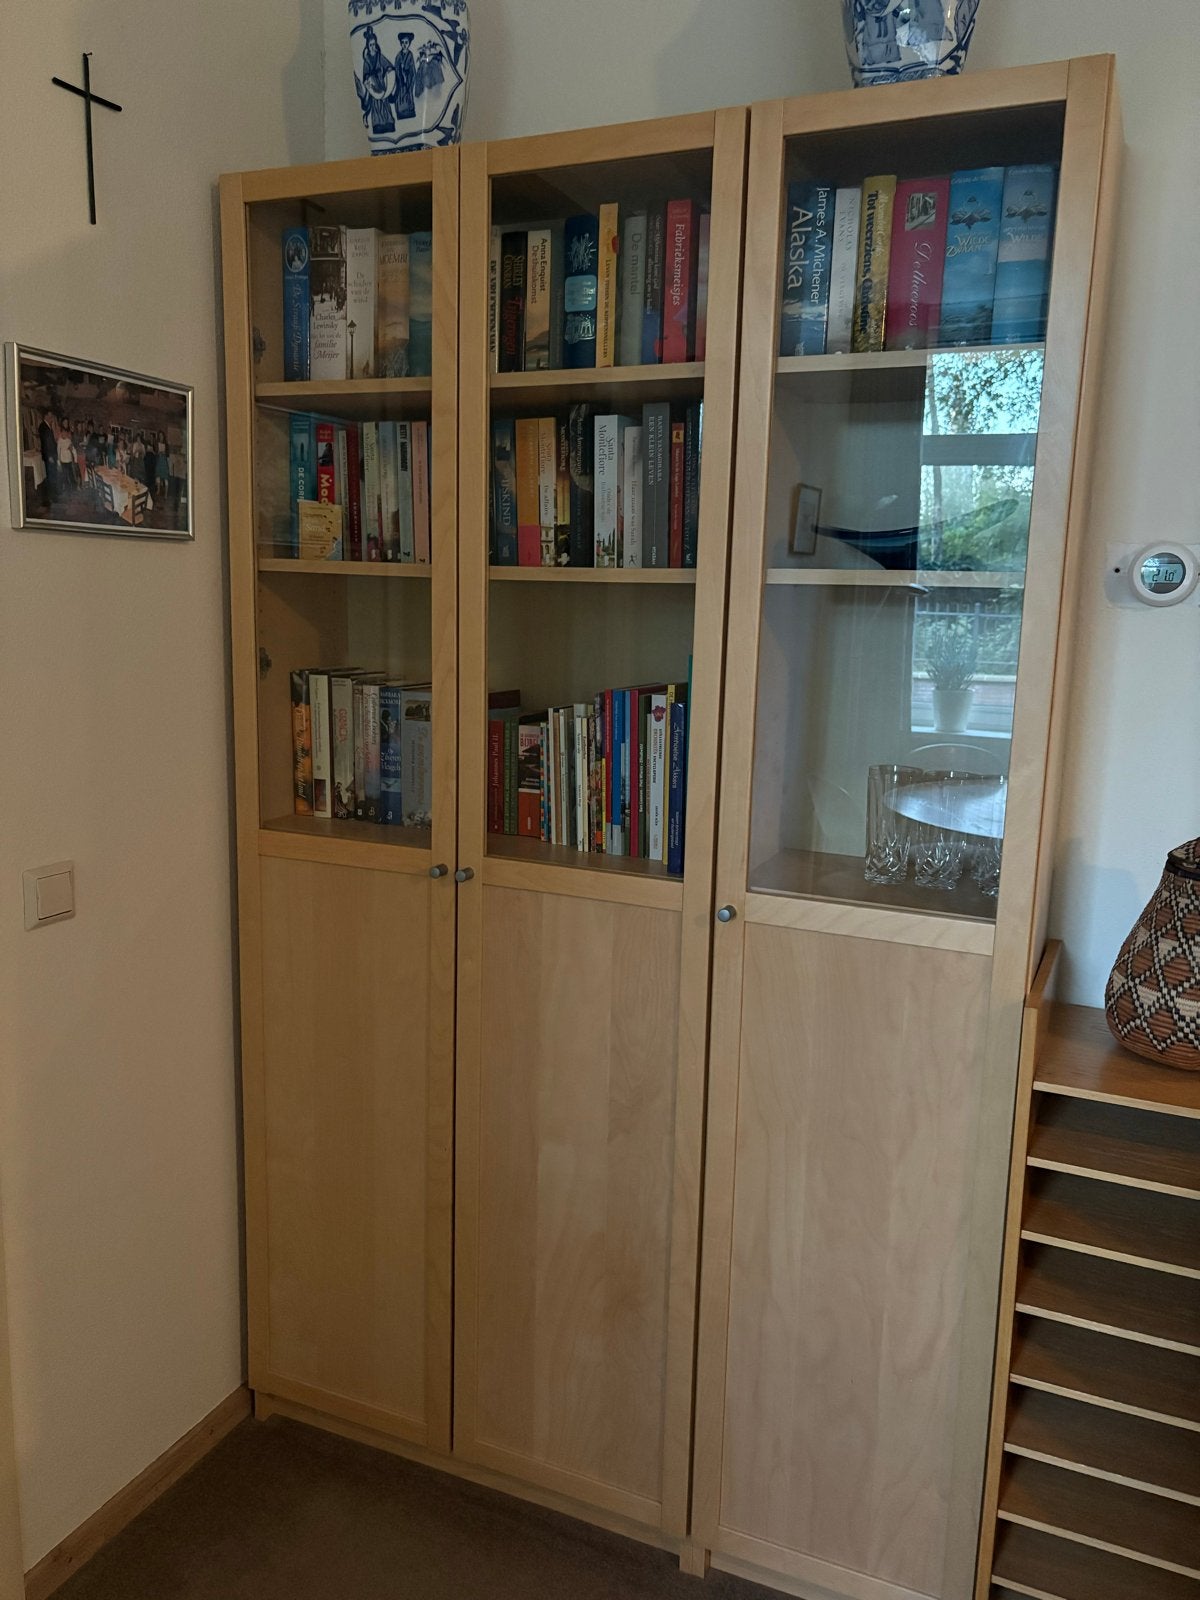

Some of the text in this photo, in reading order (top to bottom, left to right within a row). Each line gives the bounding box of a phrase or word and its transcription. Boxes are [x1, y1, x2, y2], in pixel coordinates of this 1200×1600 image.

[538, 238, 548, 292] Anna Enquist
[630, 232, 642, 296] De mantel
[670, 223, 686, 306] Fabrieksmeisjes
[786, 205, 814, 290] Alaska
[810, 187, 830, 304] James A. Michener
[860, 190, 879, 335] Tot weerziens, Christine
[512, 255, 524, 288] SHIRLEY
[312, 322, 338, 331] Lewinsky
[314, 340, 338, 349] familie
[312, 350, 340, 360] Meijer
[298, 467, 304, 478] DE
[598, 424, 608, 476] Montefiore
[606, 436, 616, 461] Santa
[500, 478, 512, 526] IJSKIND
